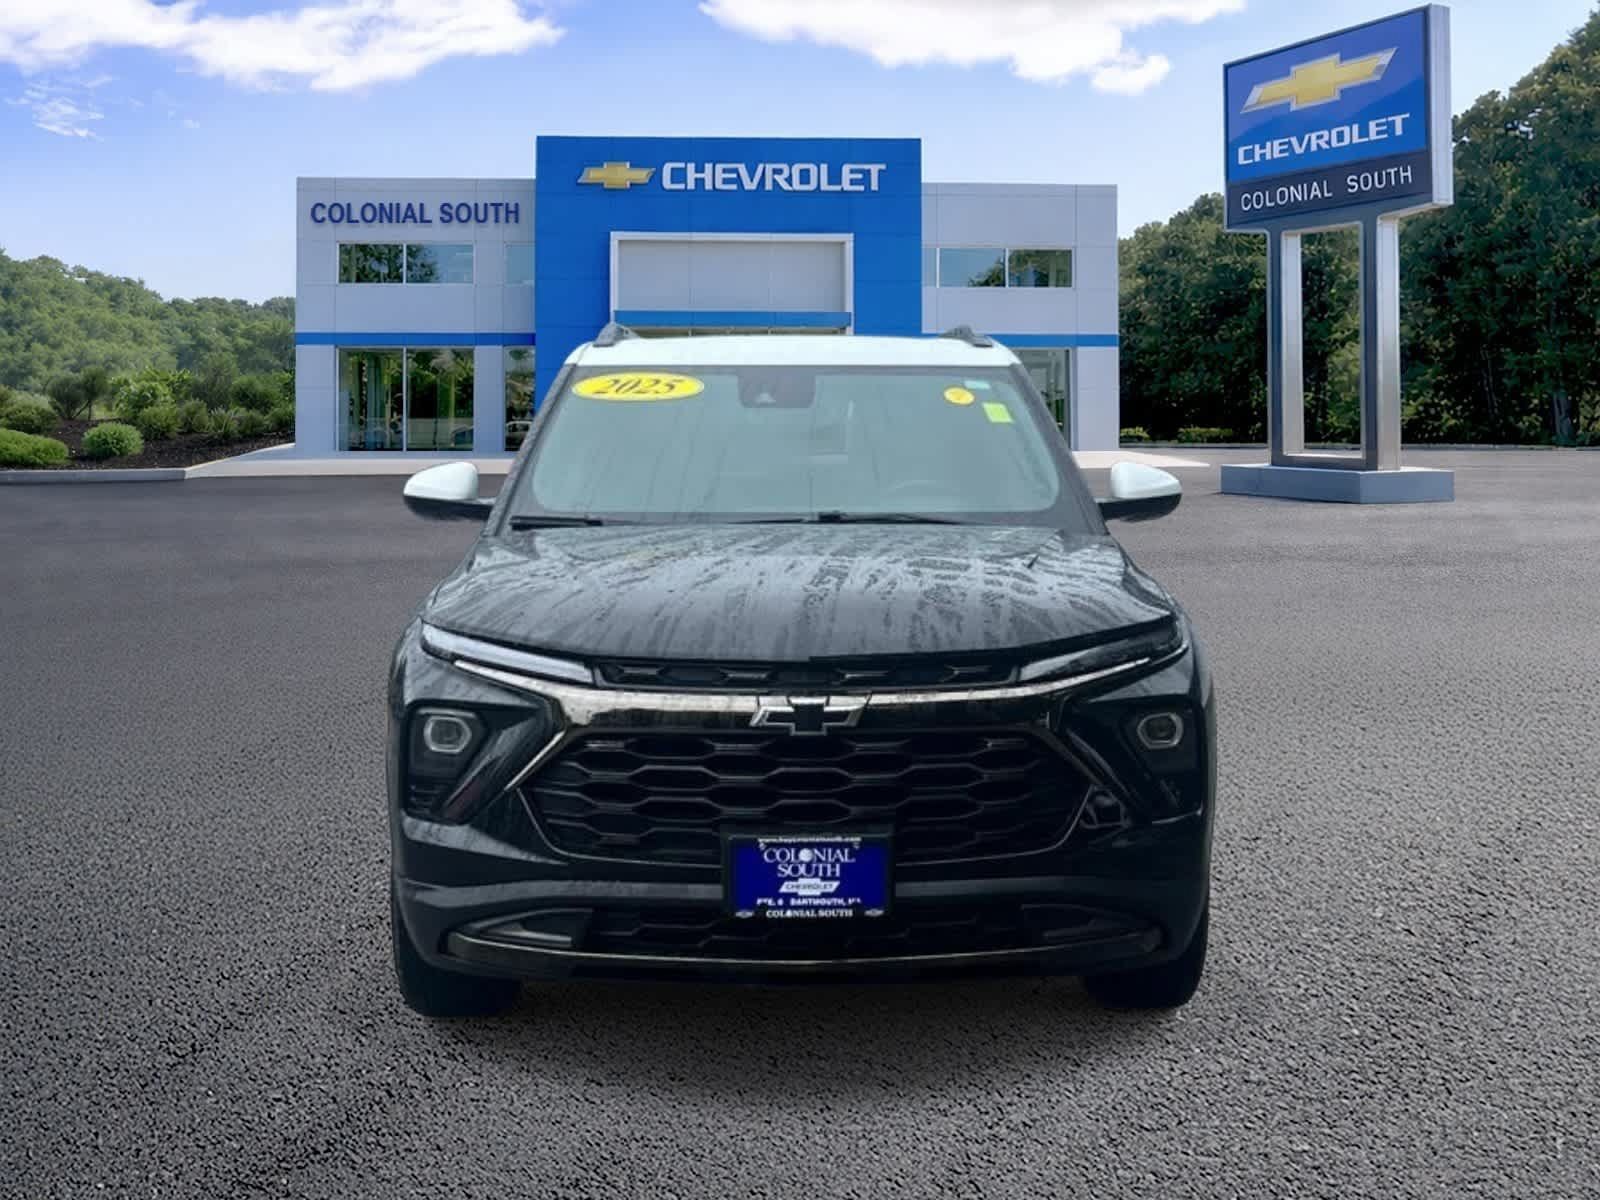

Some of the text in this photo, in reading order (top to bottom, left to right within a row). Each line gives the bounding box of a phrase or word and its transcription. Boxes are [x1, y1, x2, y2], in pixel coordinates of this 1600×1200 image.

[1237, 112, 1411, 166] CHEVROLET
[661, 161, 887, 193] CHEVROLET
[1240, 164, 1414, 212] COLONIAL SOUTH
[310, 201, 520, 225] COLONIAL SOUTH
[592, 378, 686, 395] 2025
[763, 847, 857, 864] COLONIAL
[777, 863, 841, 878] SOUTH
